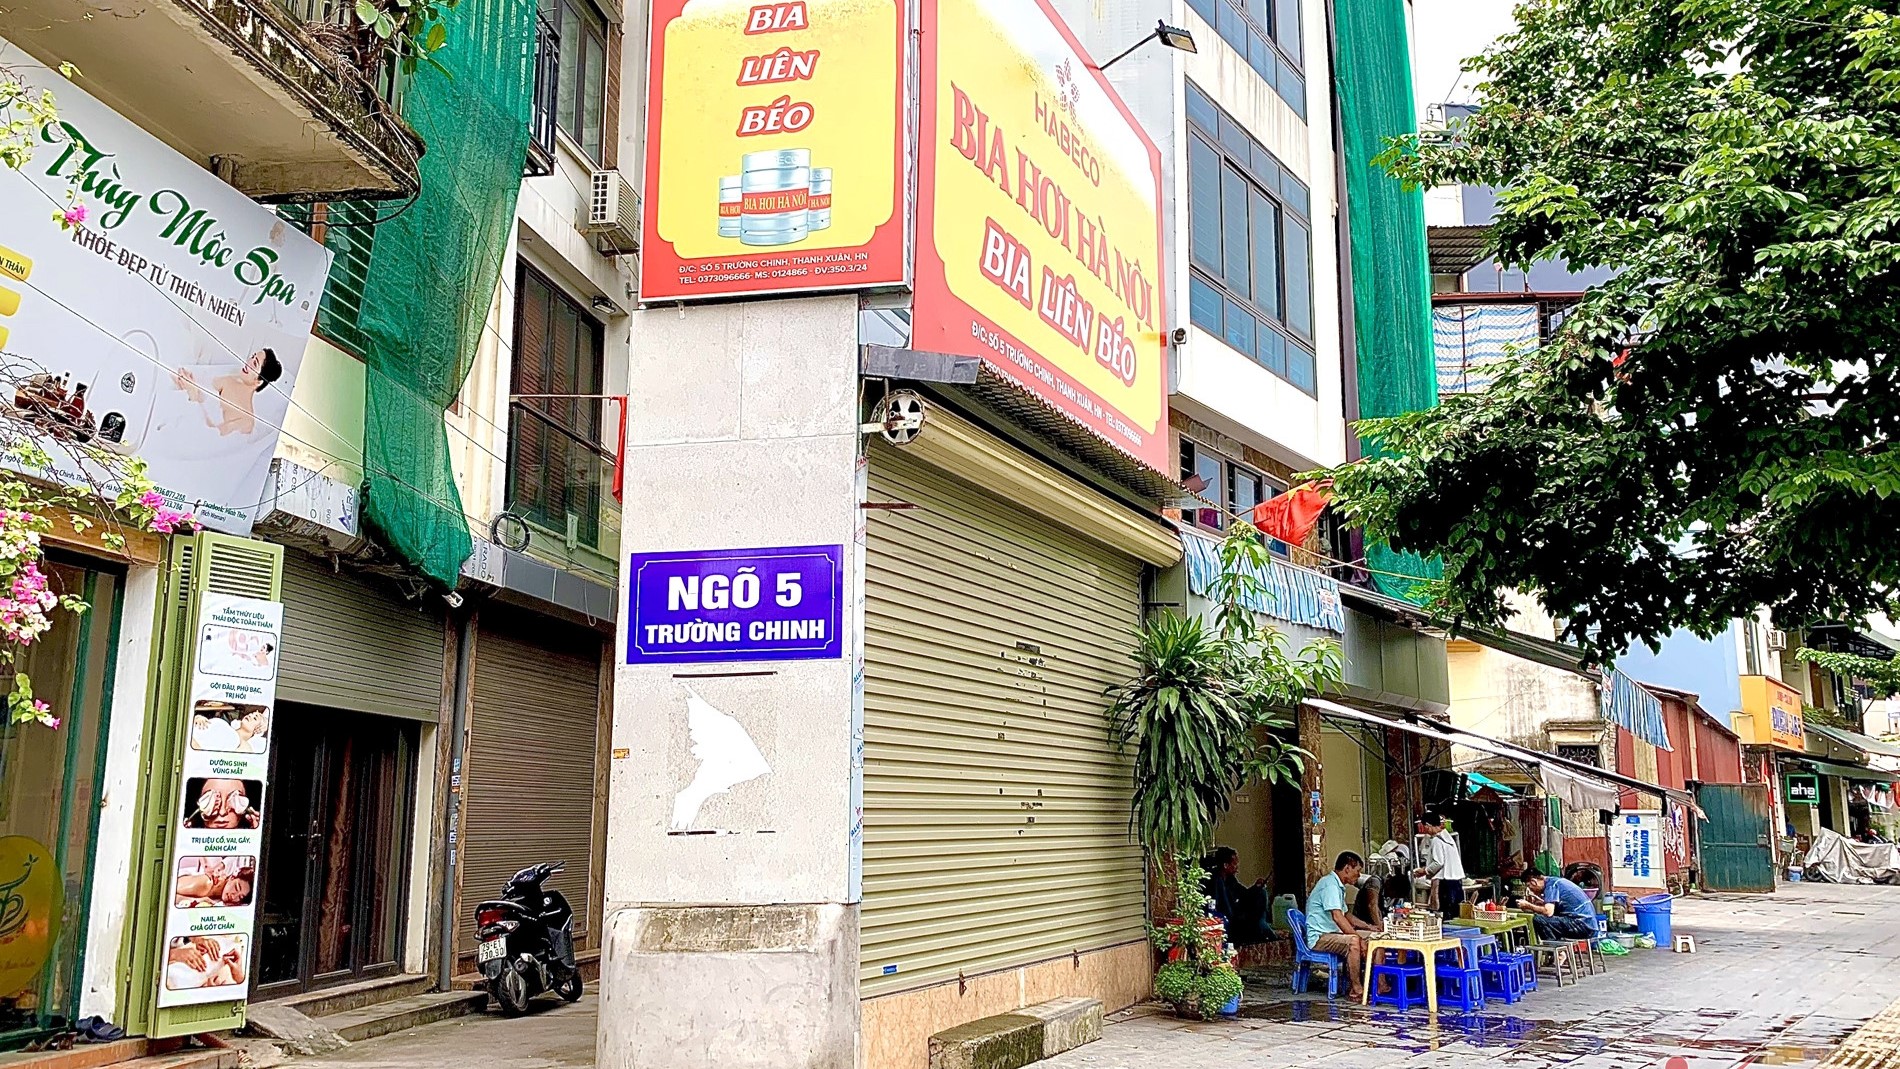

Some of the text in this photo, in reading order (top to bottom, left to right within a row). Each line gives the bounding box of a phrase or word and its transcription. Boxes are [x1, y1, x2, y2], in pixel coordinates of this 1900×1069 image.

[748, 5, 805, 32] BIA
[741, 52, 816, 83] LIÊN
[740, 99, 811, 134] BÉO
[1035, 92, 1100, 187] HABECO
[41, 120, 297, 307] Thùy Mộc Spa
[744, 198, 757, 210] BIA
[759, 197, 775, 210] HƠI
[776, 195, 791, 209] HÀ
[792, 191, 807, 208] NỘI
[950, 81, 1154, 332] BIA HƠI HÀ NỘI
[72, 225, 246, 328] KHỎE ĐẸP TỪ THIÊN NHIÊN
[679, 252, 868, 274] Đ/C: SỐ 5 TRƯỜNG CHINH, THANH XUÂN, HN
[679, 276, 696, 284] TEL:
[755, 271, 770, 279] MS:
[772, 268, 808, 278] 0124866
[982, 225, 1031, 303] BIA
[1042, 272, 1092, 350] LIÊN
[1097, 318, 1136, 382] BÉO
[972, 320, 988, 343] Đ/C:
[988, 332, 999, 351] SỐ
[1000, 339, 1005, 355] 5
[1005, 343, 1034, 374] TRƯỜNG
[1034, 363, 1055, 391] CHINH,
[1056, 377, 1076, 402] THANH
[1076, 391, 1094, 416] XUÂN,
[1094, 402, 1102, 420] HN
[667, 566, 802, 611] NGÕ 5
[645, 618, 825, 644] TRƯỜNG CHINH
[234, 760, 248, 768] SINH
[1791, 782, 1815, 796] aha
